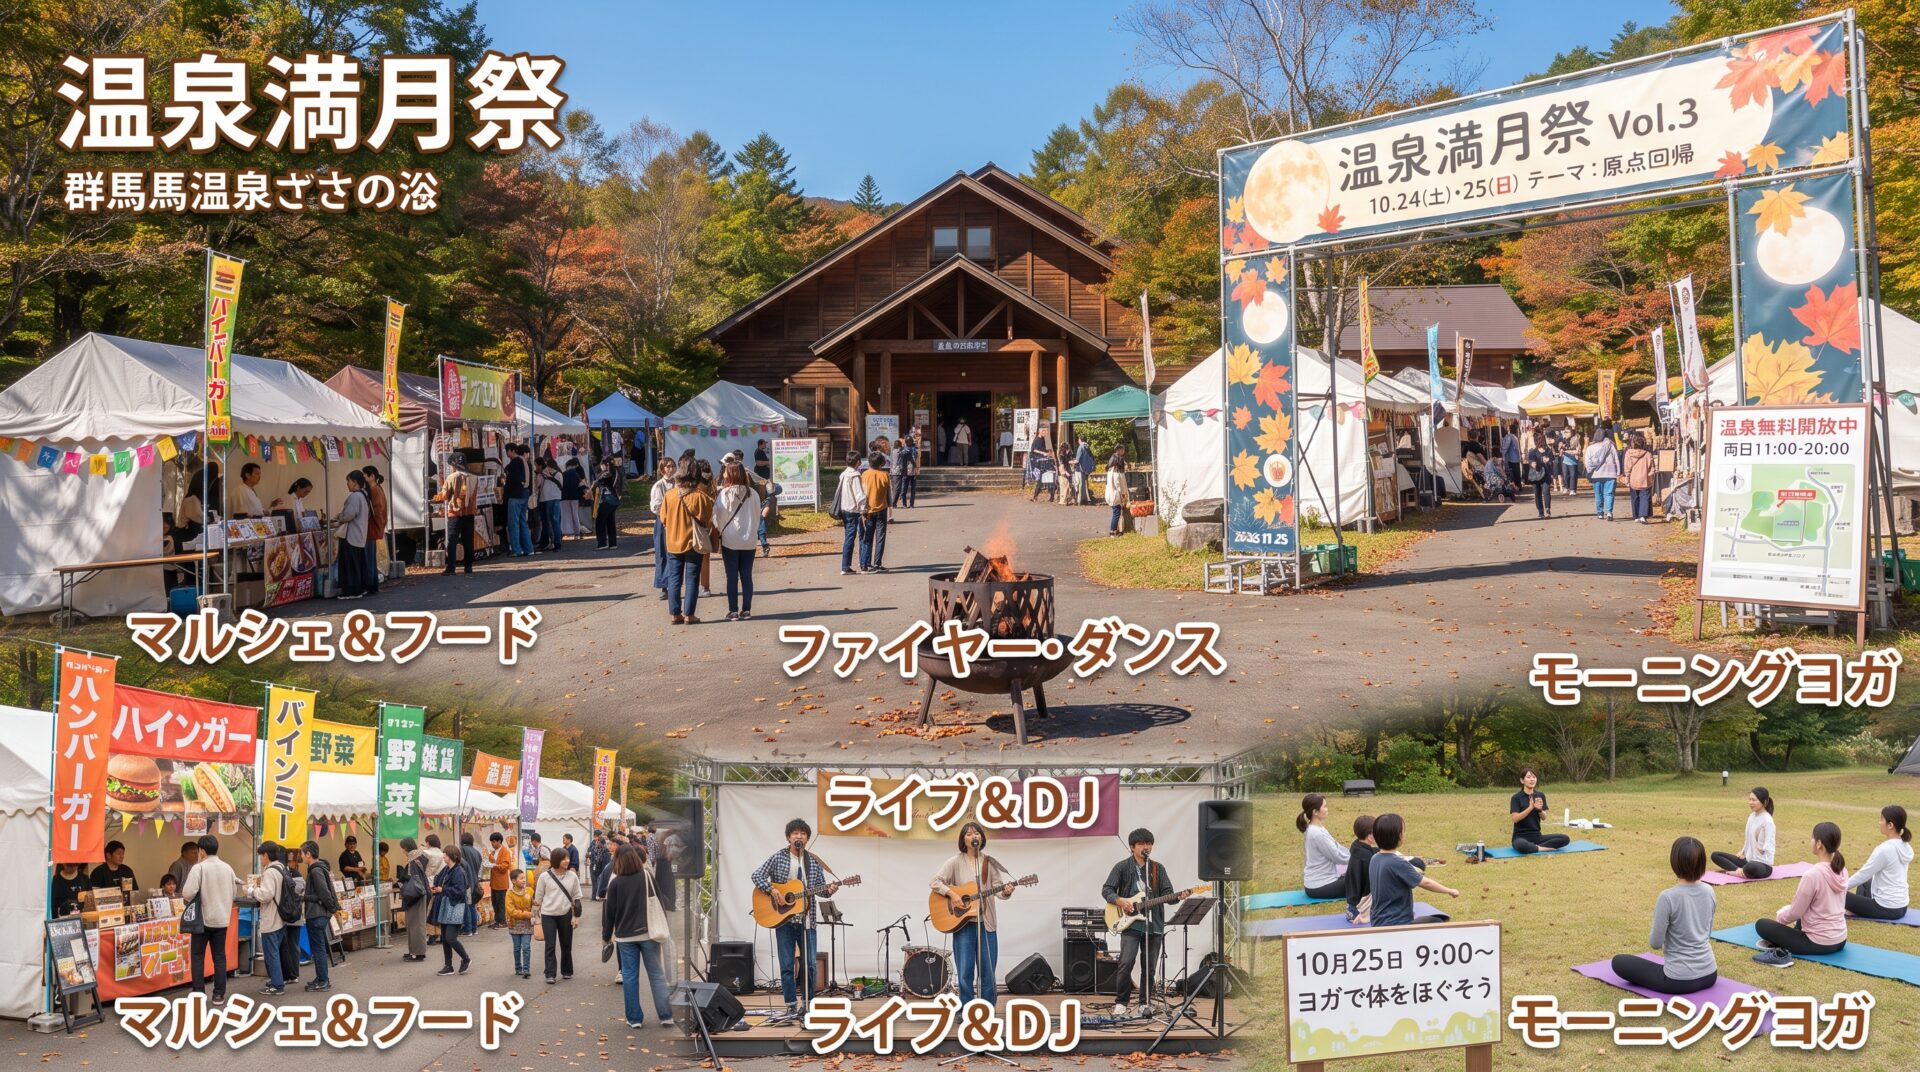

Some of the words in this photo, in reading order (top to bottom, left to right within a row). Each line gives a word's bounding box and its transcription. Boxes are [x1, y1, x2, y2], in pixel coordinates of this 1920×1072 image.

[1338, 100, 1594, 192] 温泉満月祭
[1608, 97, 1699, 140] Vol.3
[1719, 416, 1859, 437] 温泉無料開放中
[1723, 441, 1851, 458] 両日11:00-20:00
[112, 704, 252, 754] ハインガー
[61, 675, 101, 852] ハンバーガー
[310, 731, 356, 767] 野菜
[421, 742, 456, 775] 雑貨
[275, 700, 306, 841] バインミー
[384, 738, 416, 818] 野菜
[1296, 947, 1403, 977] 10月25日
[1298, 976, 1492, 1013] ヨガで体をほぐそう
